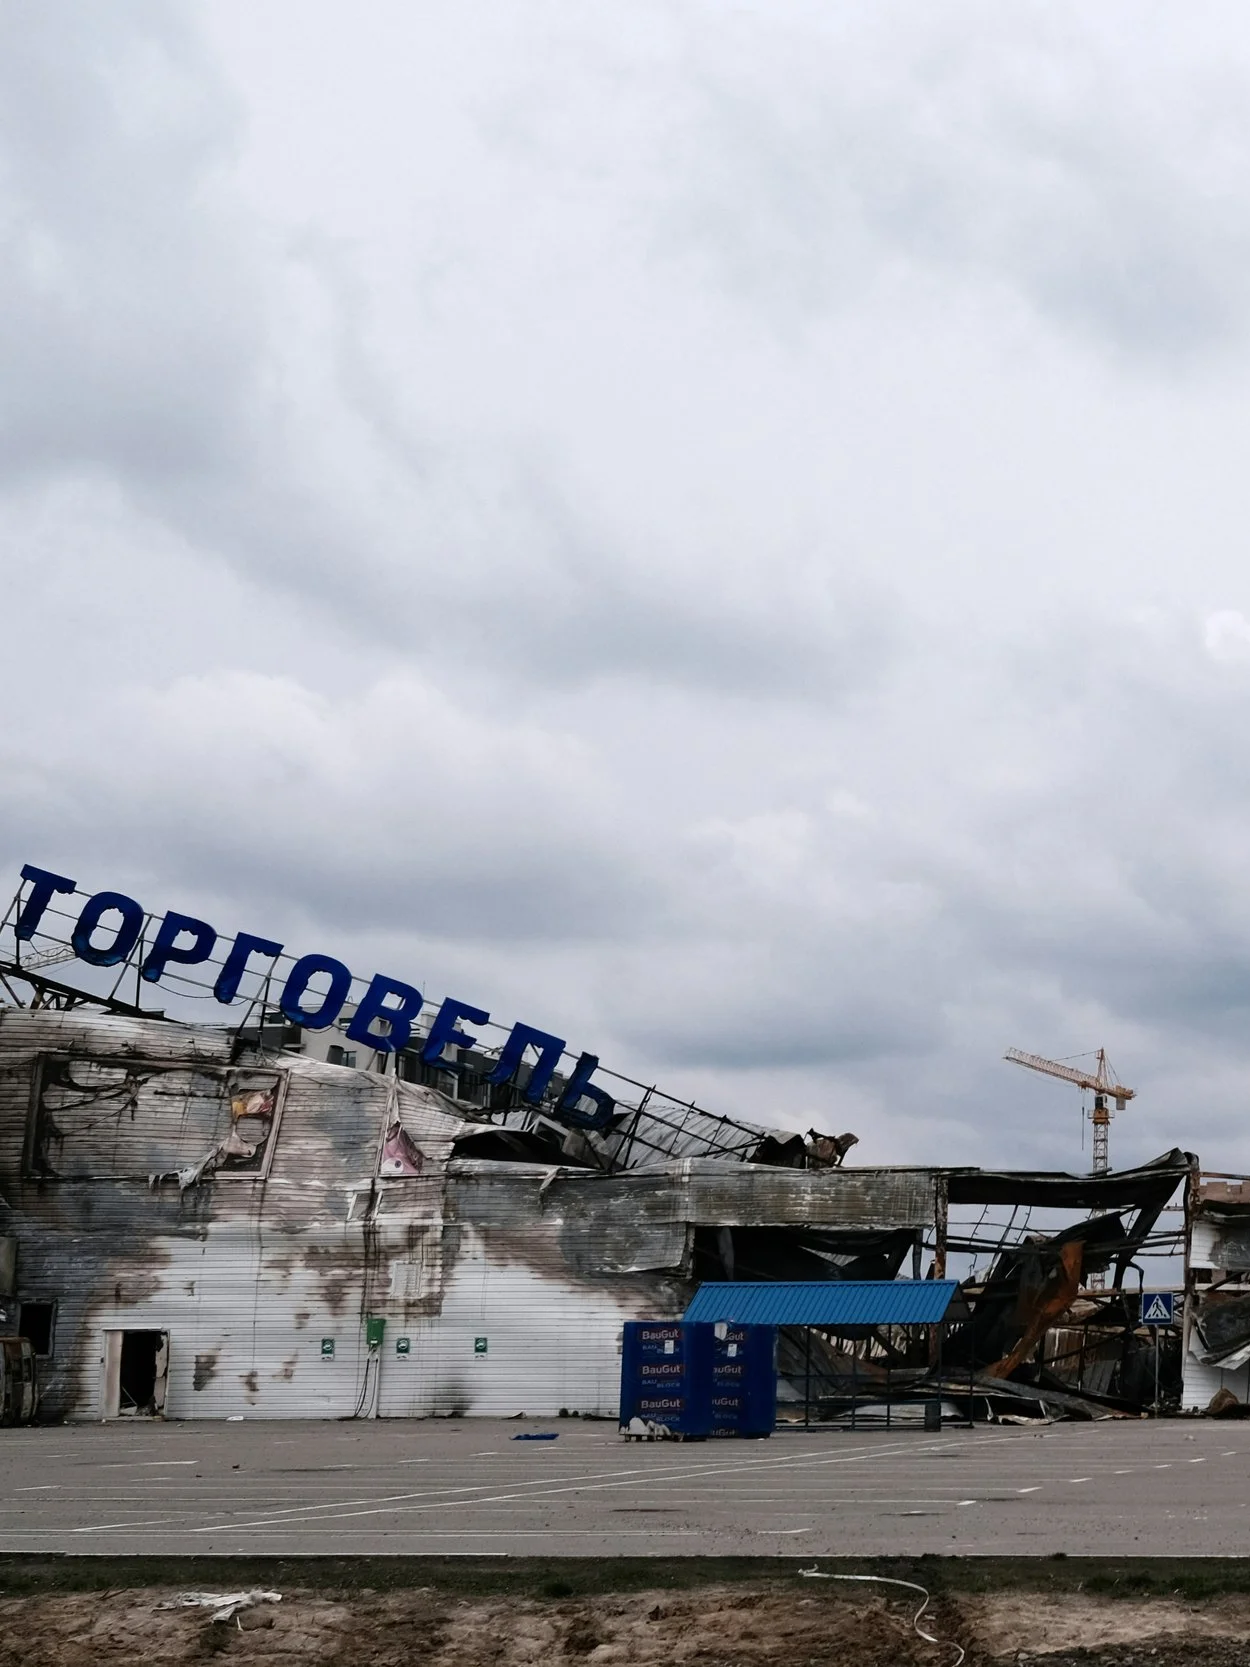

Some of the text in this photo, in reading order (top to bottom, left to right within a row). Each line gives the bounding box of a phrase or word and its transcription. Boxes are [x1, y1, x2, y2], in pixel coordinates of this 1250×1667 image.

[14, 864, 617, 1130] ТОРГОВЕЛЬ
[642, 1328, 679, 1340] BauGut
[642, 1365, 680, 1375] BauGut
[641, 1399, 680, 1409] BauGut
